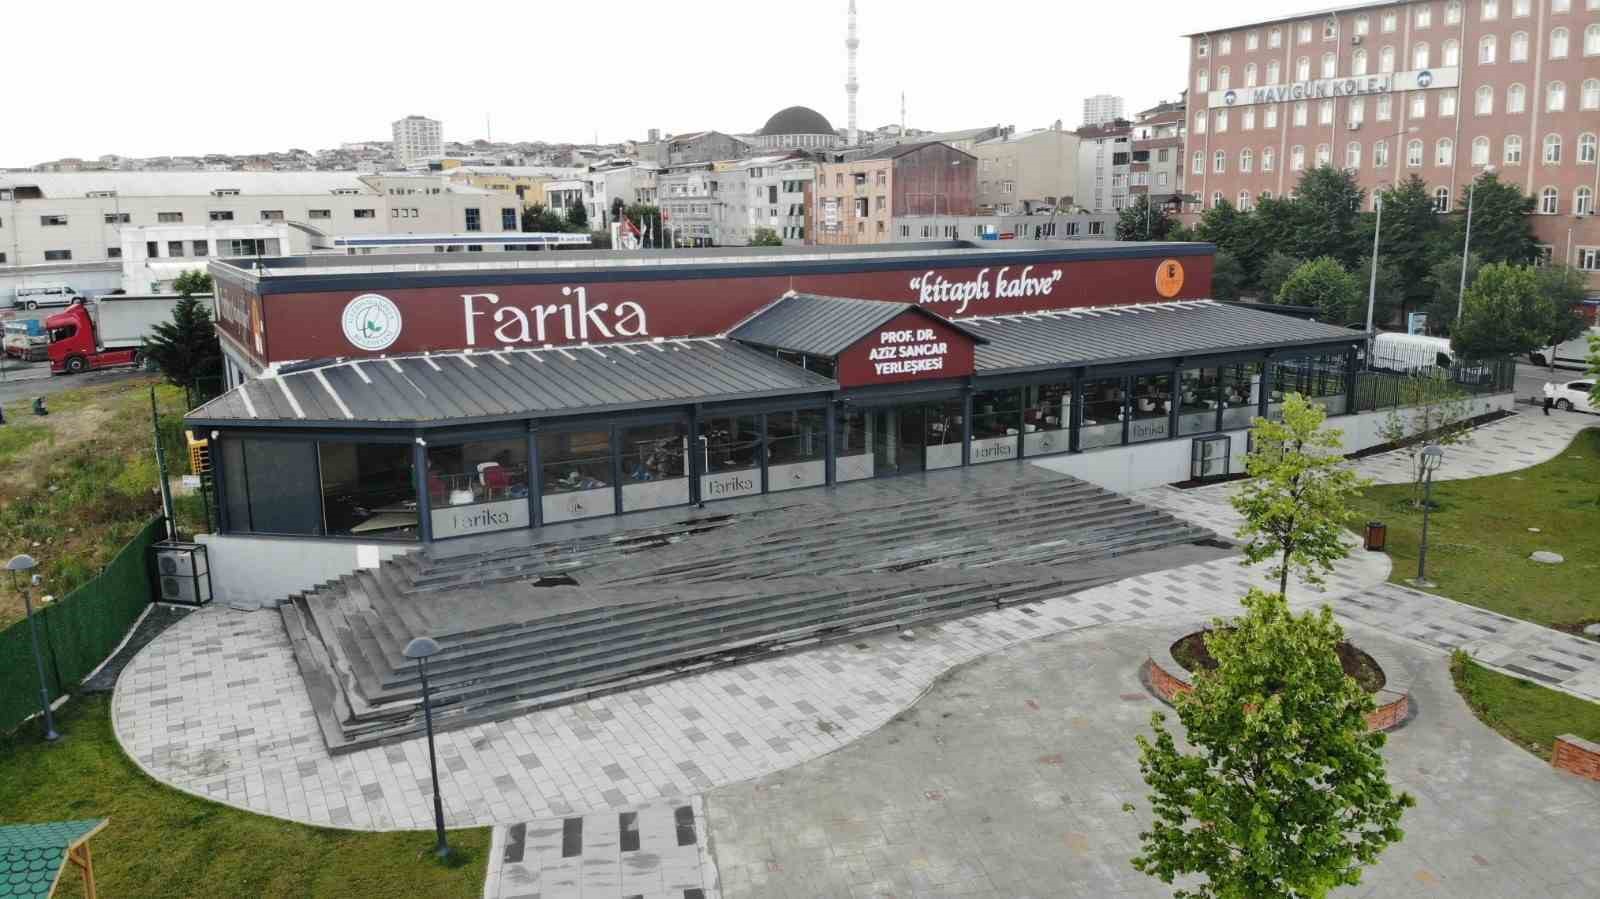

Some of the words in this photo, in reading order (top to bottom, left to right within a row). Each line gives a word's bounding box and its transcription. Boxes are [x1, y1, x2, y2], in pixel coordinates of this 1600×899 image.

[460, 286, 649, 345] Farika
[880, 330, 915, 344] PROF.
[916, 328, 936, 342] DR.
[869, 346, 897, 360] AZİZ
[898, 343, 947, 358] SANCAR
[874, 357, 943, 375] YERLEŞKESİ
